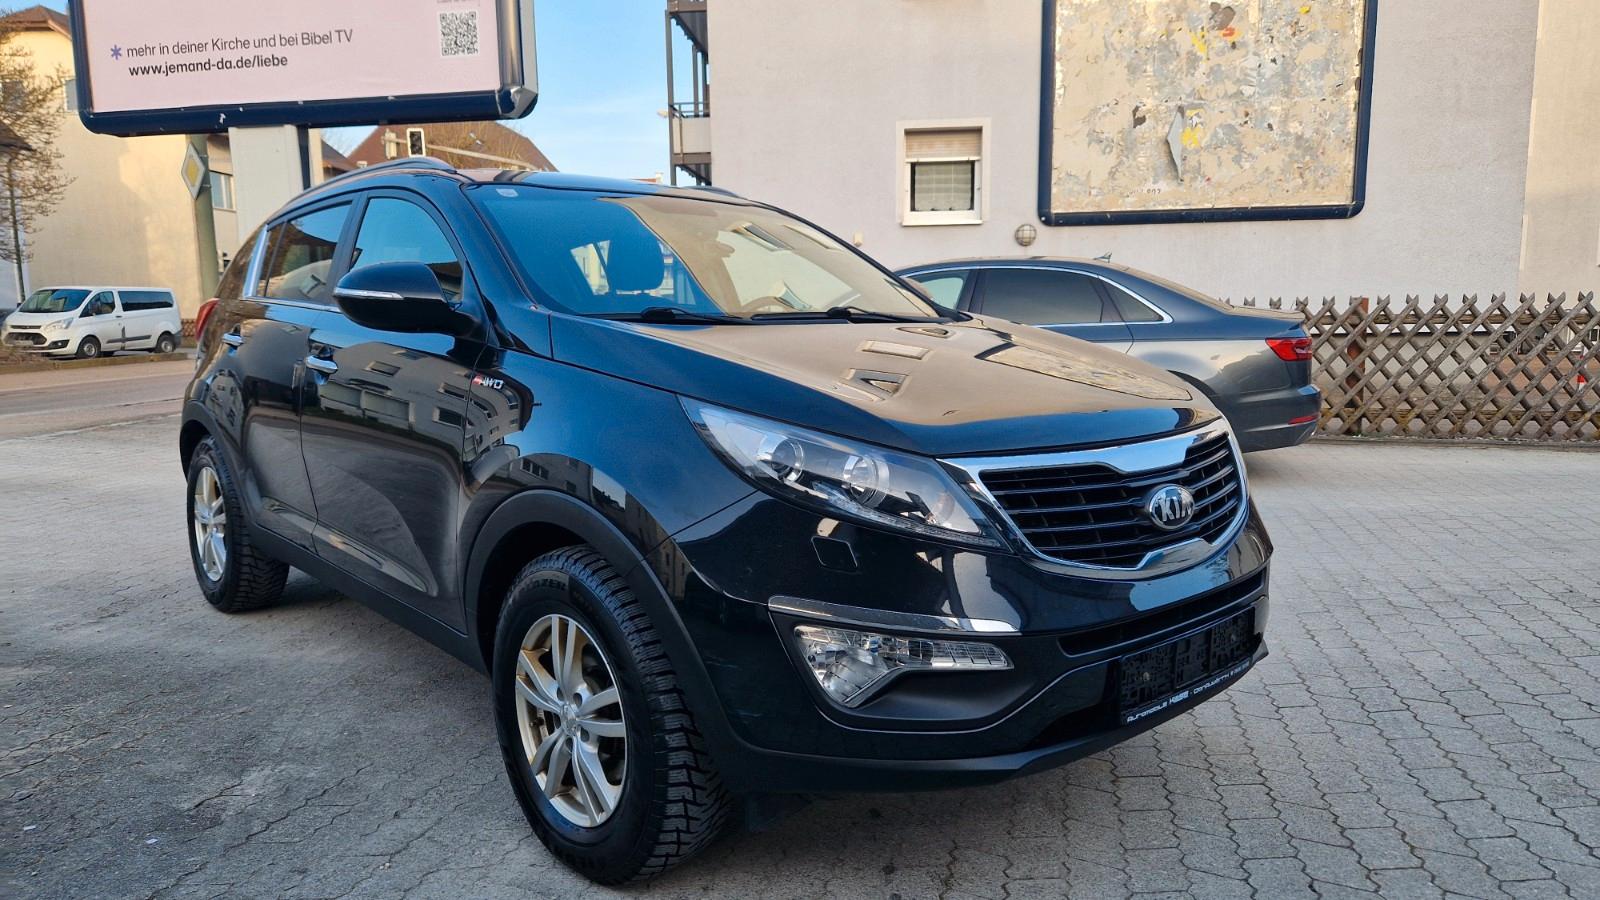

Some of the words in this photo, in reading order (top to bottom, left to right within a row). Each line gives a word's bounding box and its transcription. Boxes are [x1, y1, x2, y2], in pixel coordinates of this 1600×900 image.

[127, 42, 156, 58] mehr
[159, 43, 169, 55] in
[172, 41, 209, 54] deiner
[211, 37, 251, 51] Kirche
[253, 34, 276, 49] und
[279, 33, 298, 47] bei
[301, 31, 333, 46] Bibel
[334, 29, 353, 43] TV
[128, 54, 288, 77] www.jemand-da.de/liebe
[1154, 488, 1193, 522] KIA
